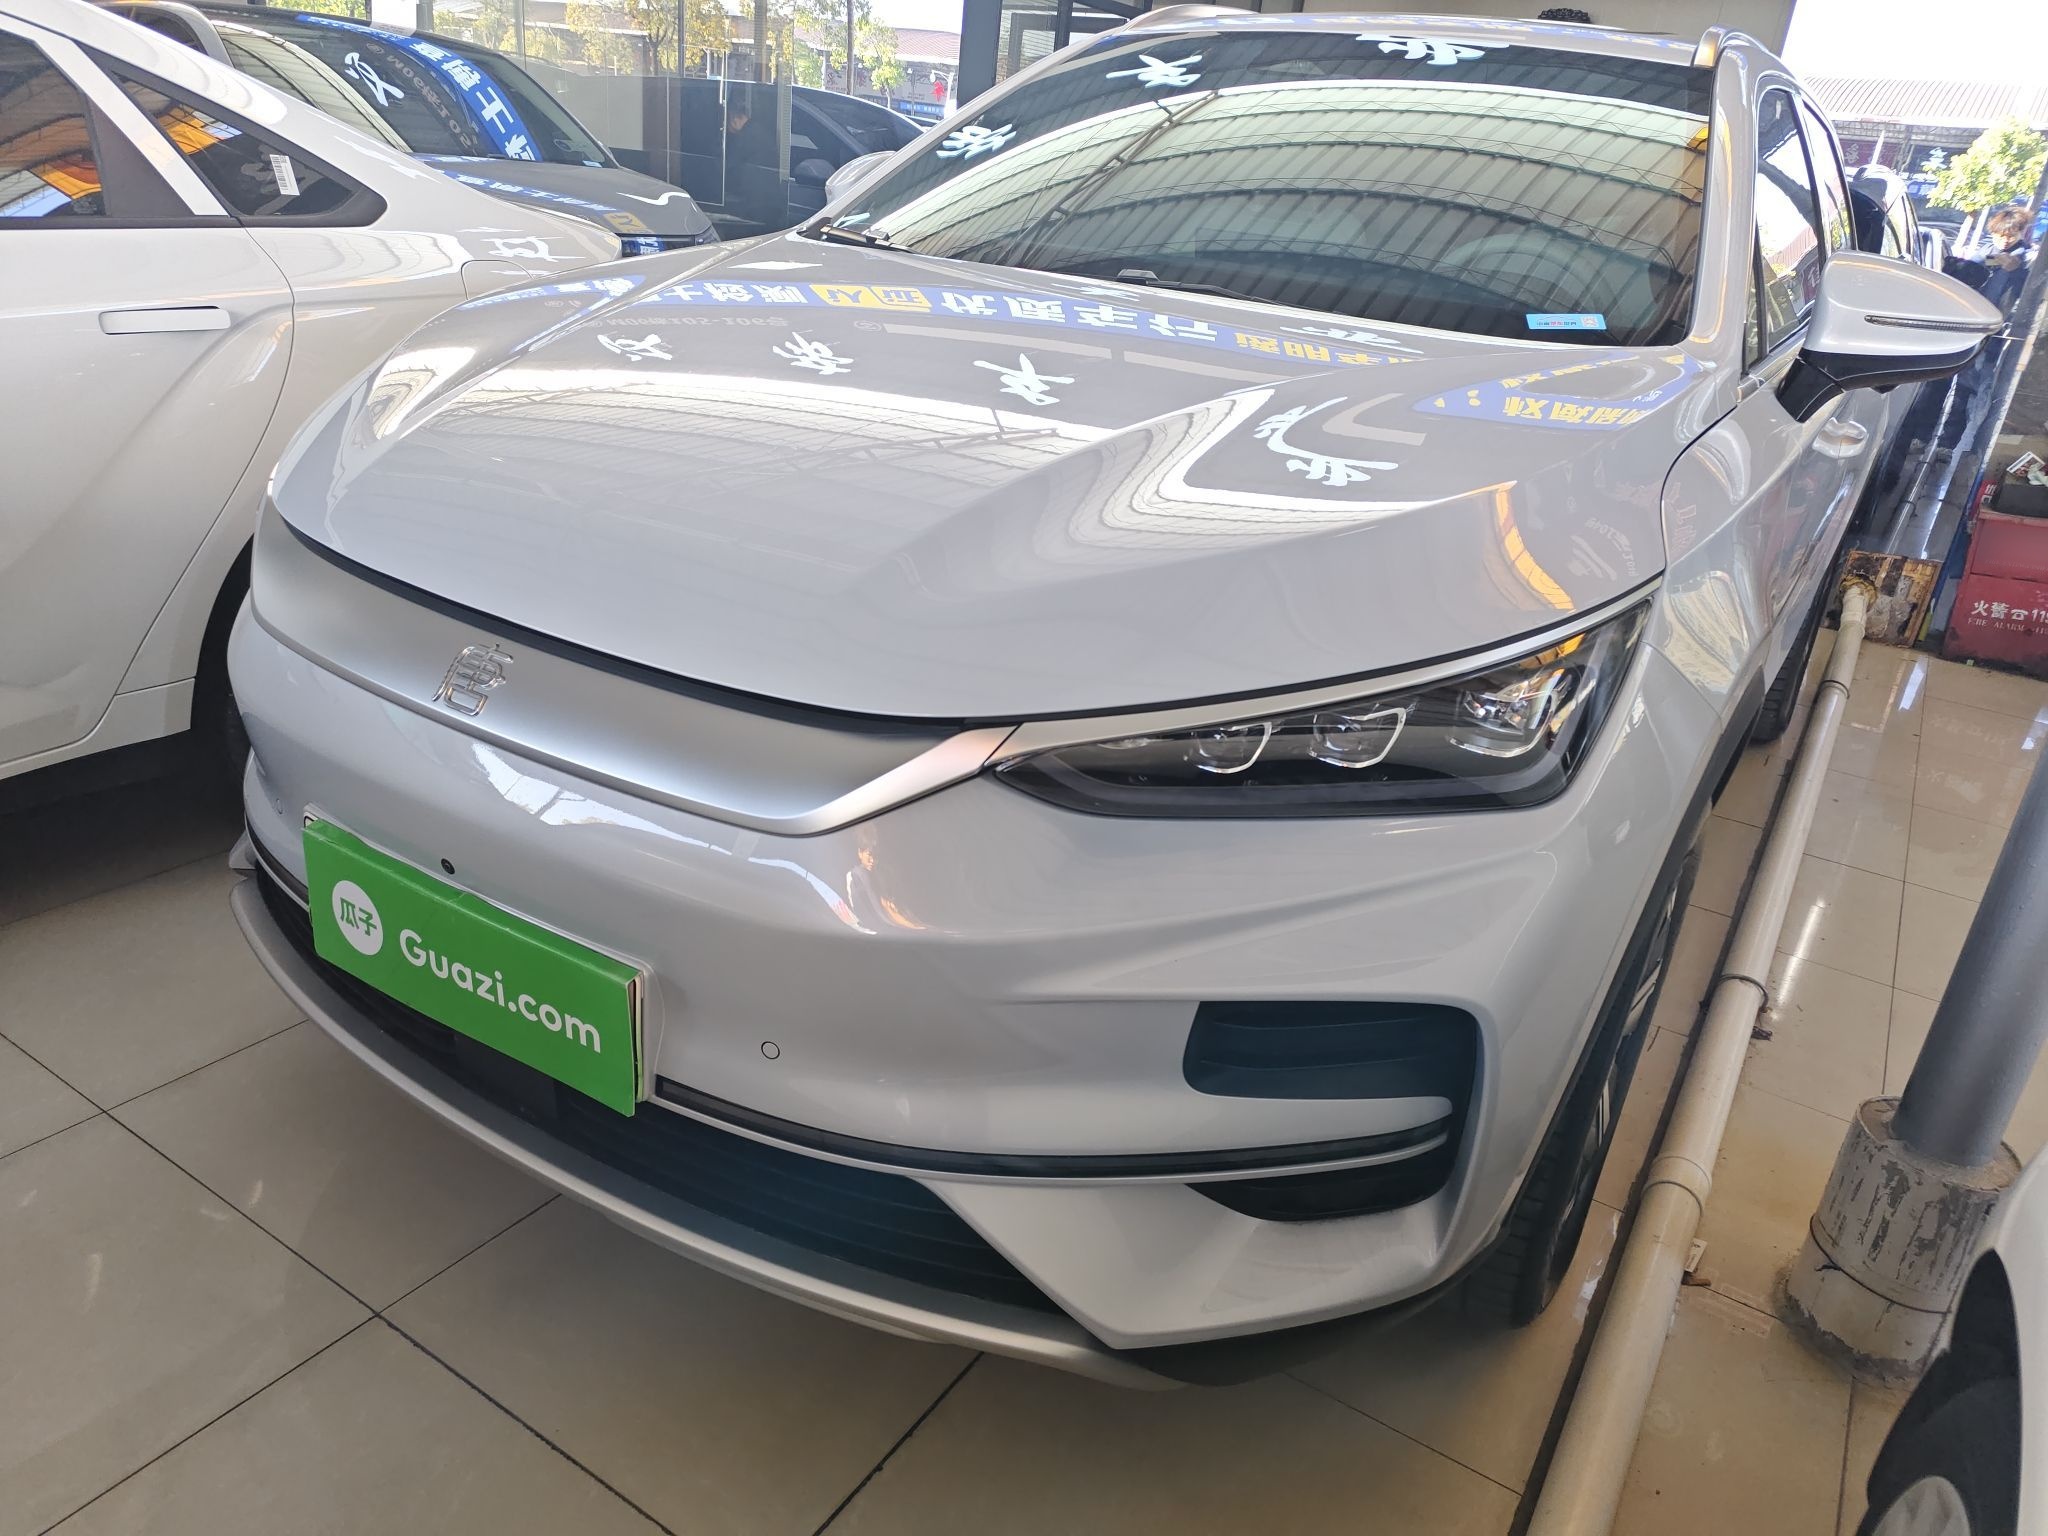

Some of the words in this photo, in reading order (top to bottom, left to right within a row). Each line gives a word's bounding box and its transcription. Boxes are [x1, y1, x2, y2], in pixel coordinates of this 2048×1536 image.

[1971, 600, 2010, 619] 火警
[338, 896, 378, 937] 瓜子
[399, 927, 602, 1055] Guazi.com
